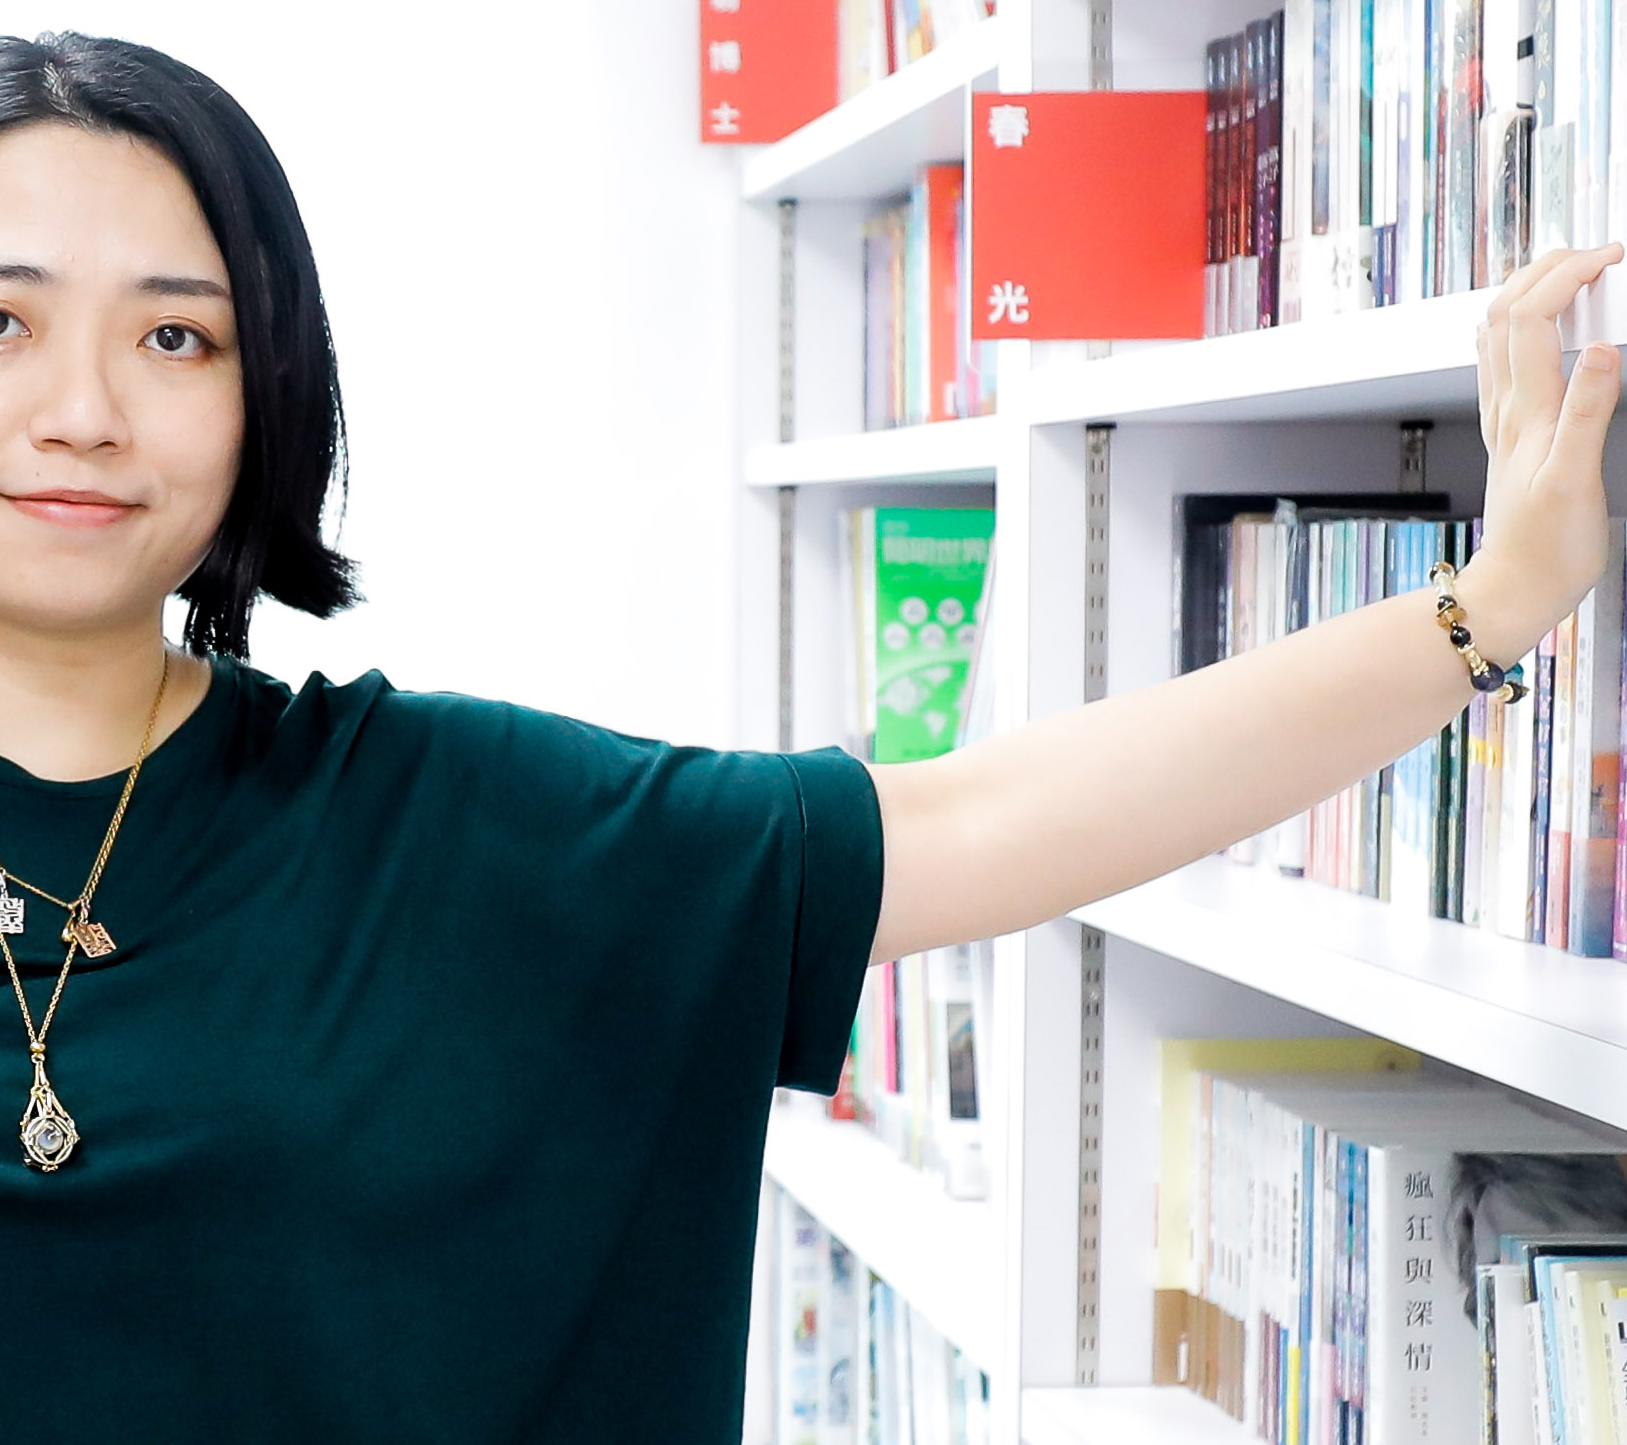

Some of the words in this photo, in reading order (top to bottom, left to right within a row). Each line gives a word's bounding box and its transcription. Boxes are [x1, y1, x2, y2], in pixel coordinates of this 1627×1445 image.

[988, 104, 1030, 325] 春光
[1402, 1168, 1435, 1374] 瘋狂與深情
